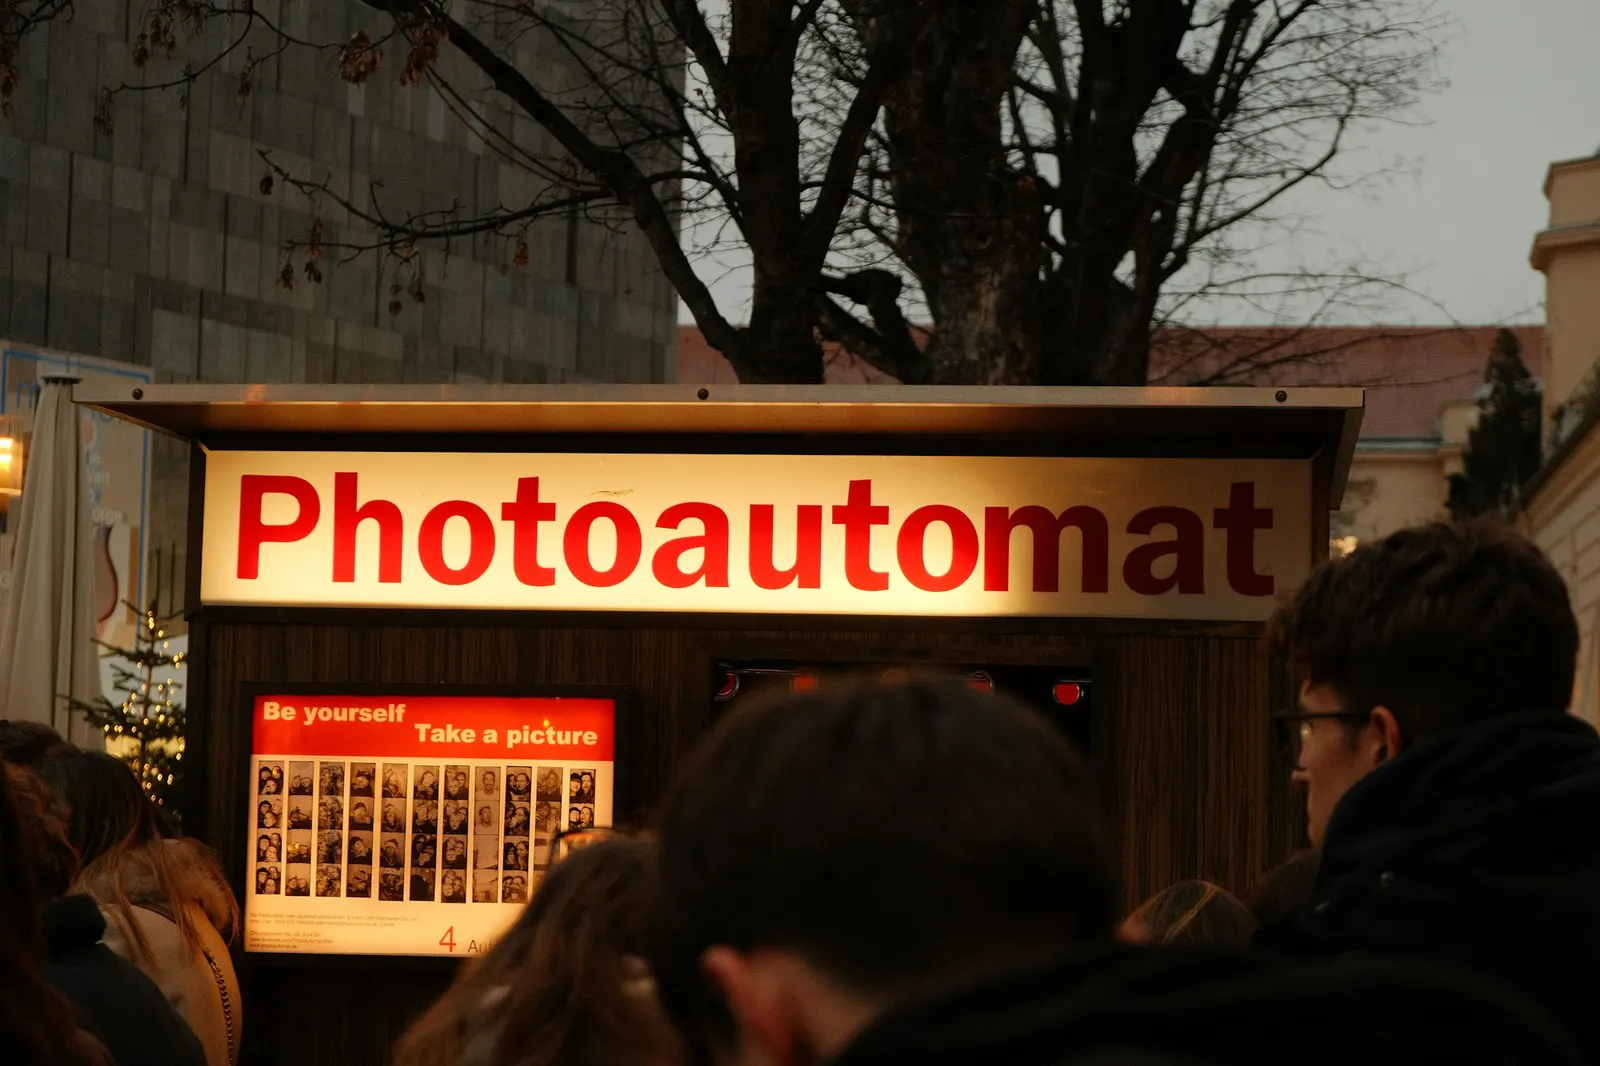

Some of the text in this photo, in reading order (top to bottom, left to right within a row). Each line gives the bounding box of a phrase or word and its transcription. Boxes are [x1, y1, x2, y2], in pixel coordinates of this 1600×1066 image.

[236, 471, 1275, 597] Photoautomat
[263, 702, 406, 726] Be yourself
[414, 723, 598, 748] Take a picture
[439, 926, 457, 953] 4
